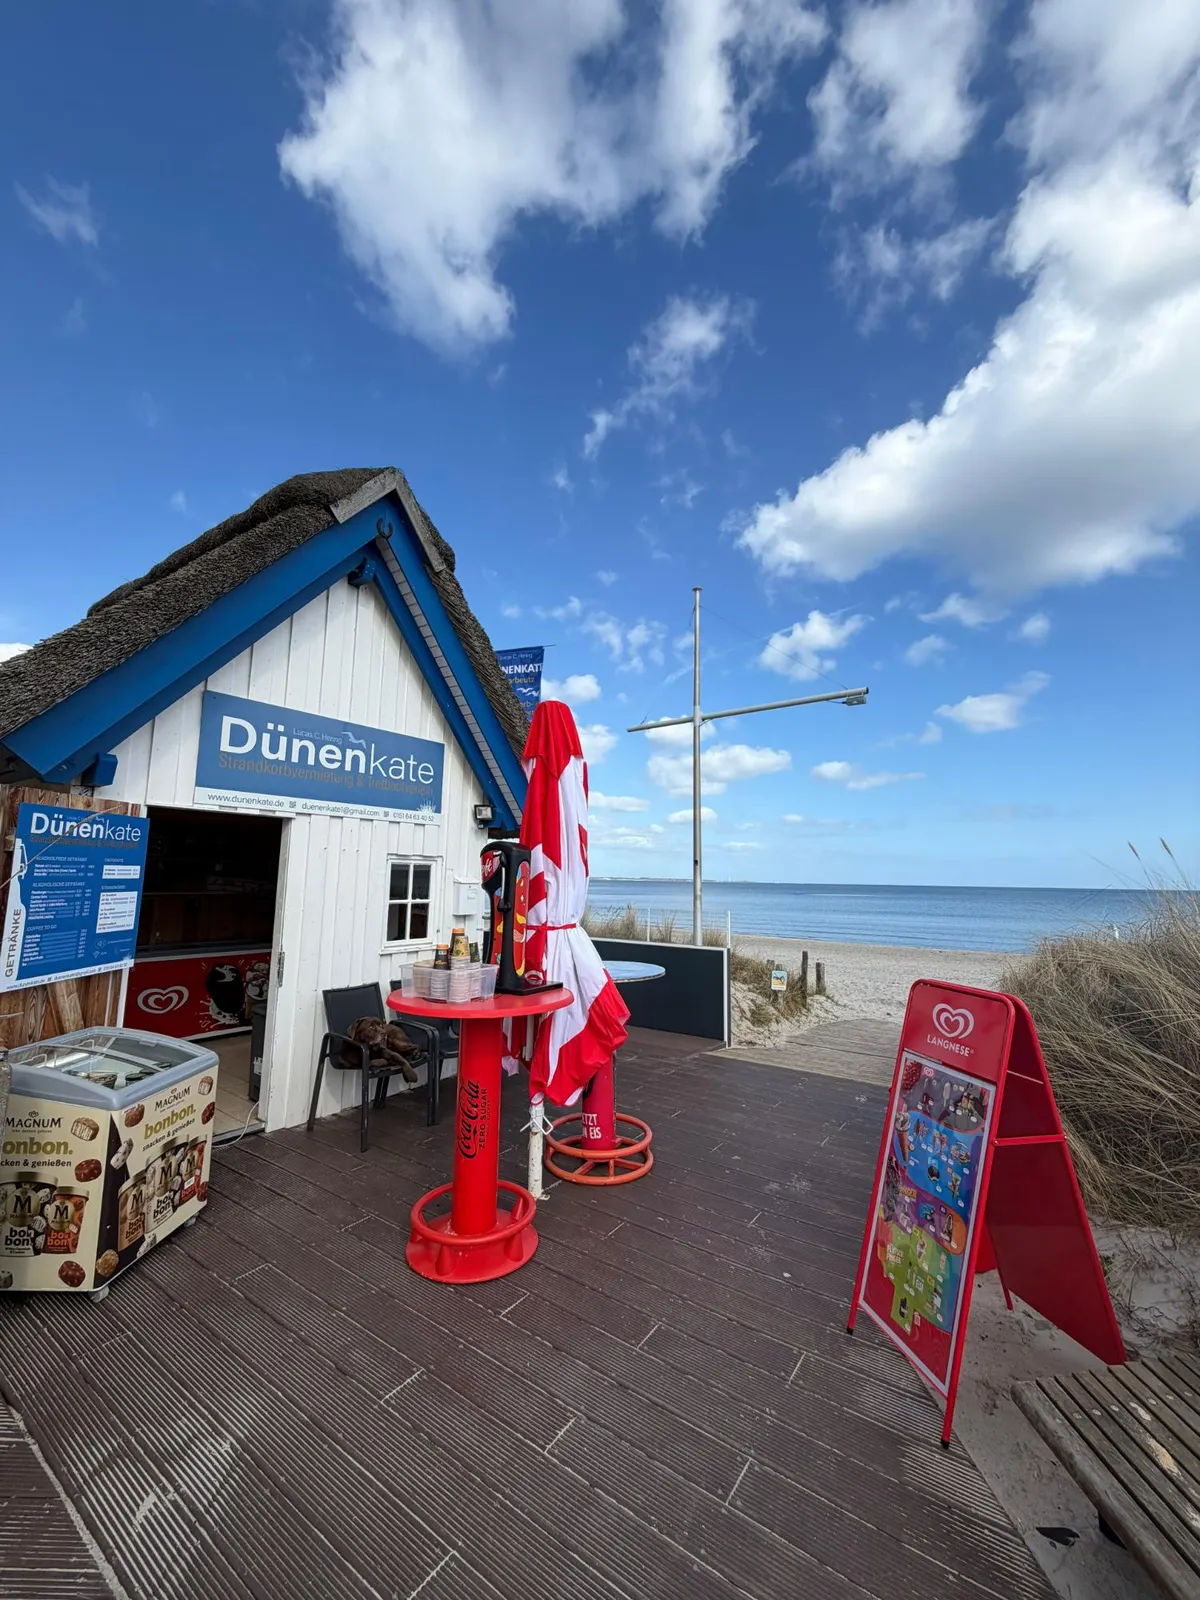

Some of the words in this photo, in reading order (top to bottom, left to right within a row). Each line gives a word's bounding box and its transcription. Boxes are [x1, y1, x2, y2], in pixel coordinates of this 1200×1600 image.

[293, 727, 314, 738] Lucas
[220, 715, 434, 784] Dünenkate
[218, 753, 354, 789] Strandkorbvermietung
[357, 775, 364, 787] &
[30, 812, 141, 842] Dünenkate
[5, 908, 22, 978] GETRÄNKE
[927, 1034, 970, 1057] LANGNESE
[154, 1086, 191, 1112] MAGNUM
[6, 1117, 62, 1128] MAGNUM
[2, 1137, 74, 1155] onbon.
[142, 1135, 166, 1152] snacken
[166, 1130, 171, 1138] &
[172, 1118, 196, 1137] genießen
[0, 1159, 20, 1167] cken
[22, 1159, 29, 1167] &
[31, 1159, 72, 1168] genießen
[159, 1161, 173, 1186] M
[13, 1194, 32, 1213] M
[130, 1189, 143, 1211] M
[53, 1204, 69, 1220] M
